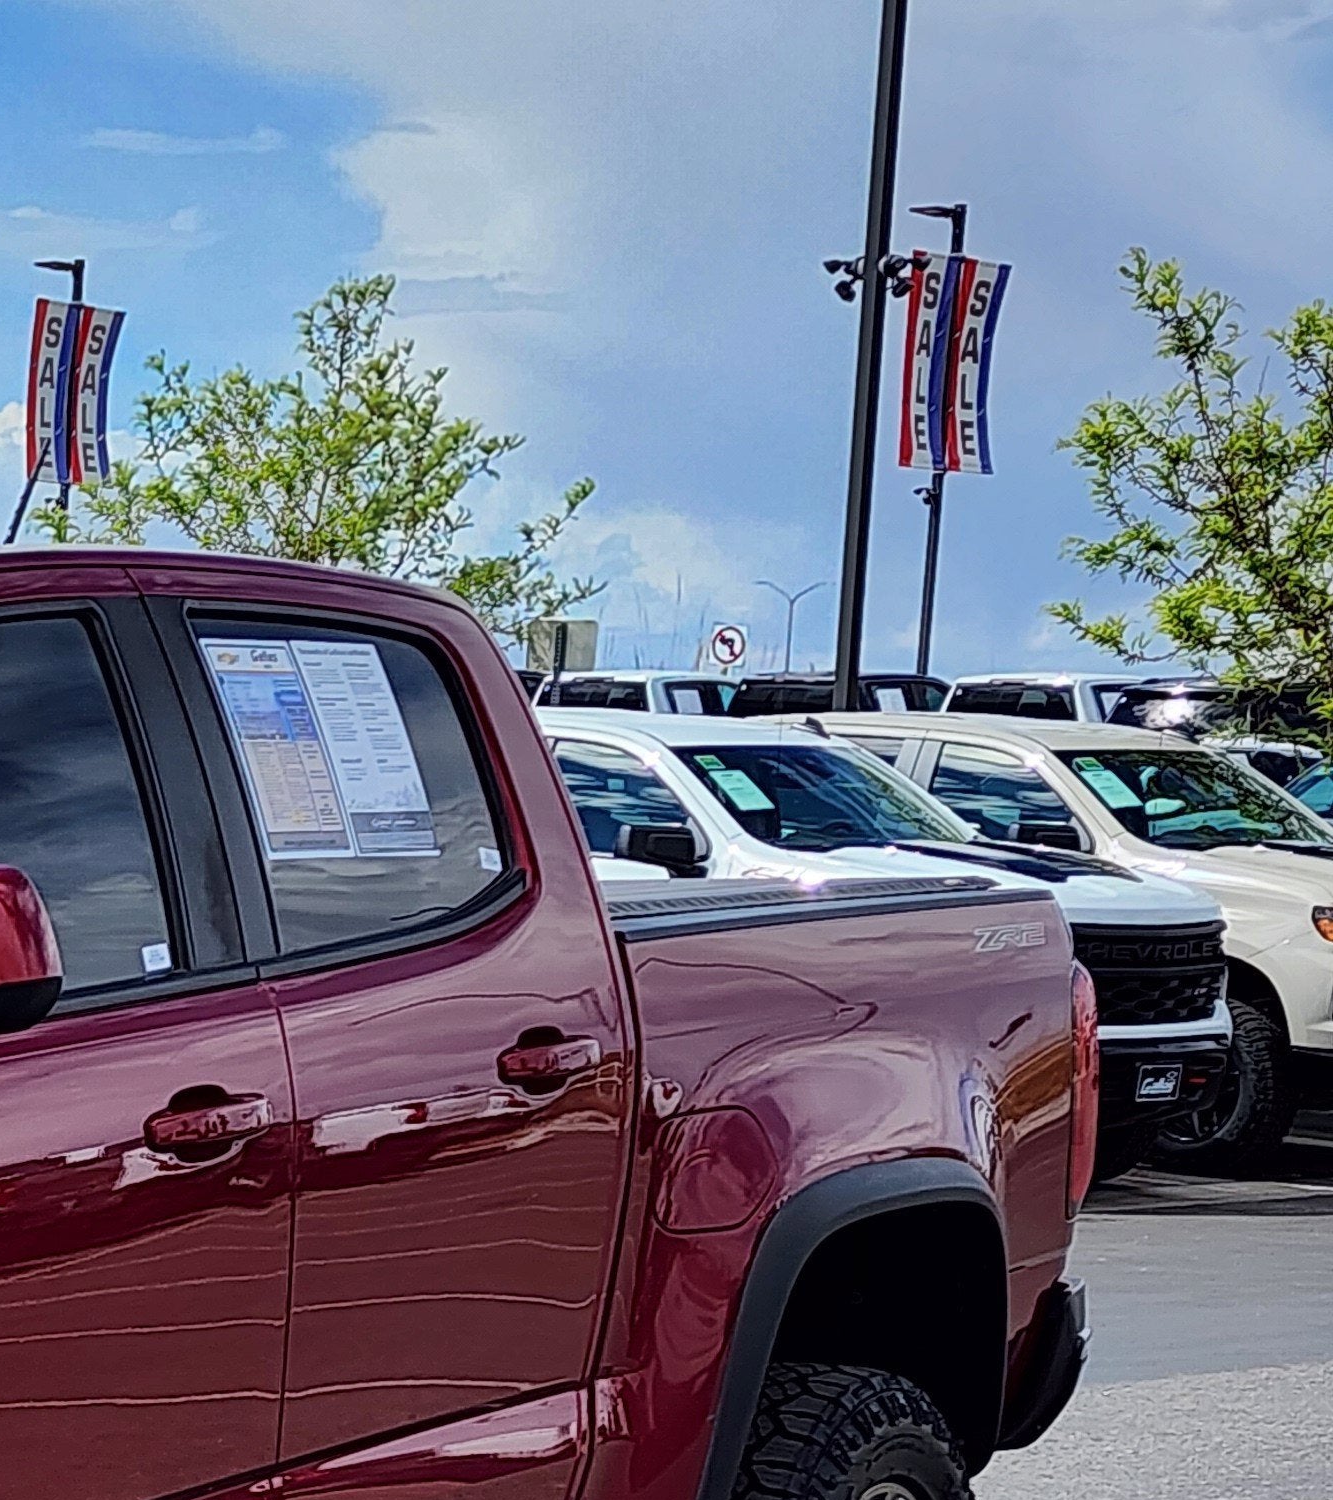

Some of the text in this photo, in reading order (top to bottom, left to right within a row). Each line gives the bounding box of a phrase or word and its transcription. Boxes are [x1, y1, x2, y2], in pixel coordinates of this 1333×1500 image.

[80, 324, 107, 473] SALE
[915, 271, 941, 451] SALE
[960, 279, 991, 456] SALE
